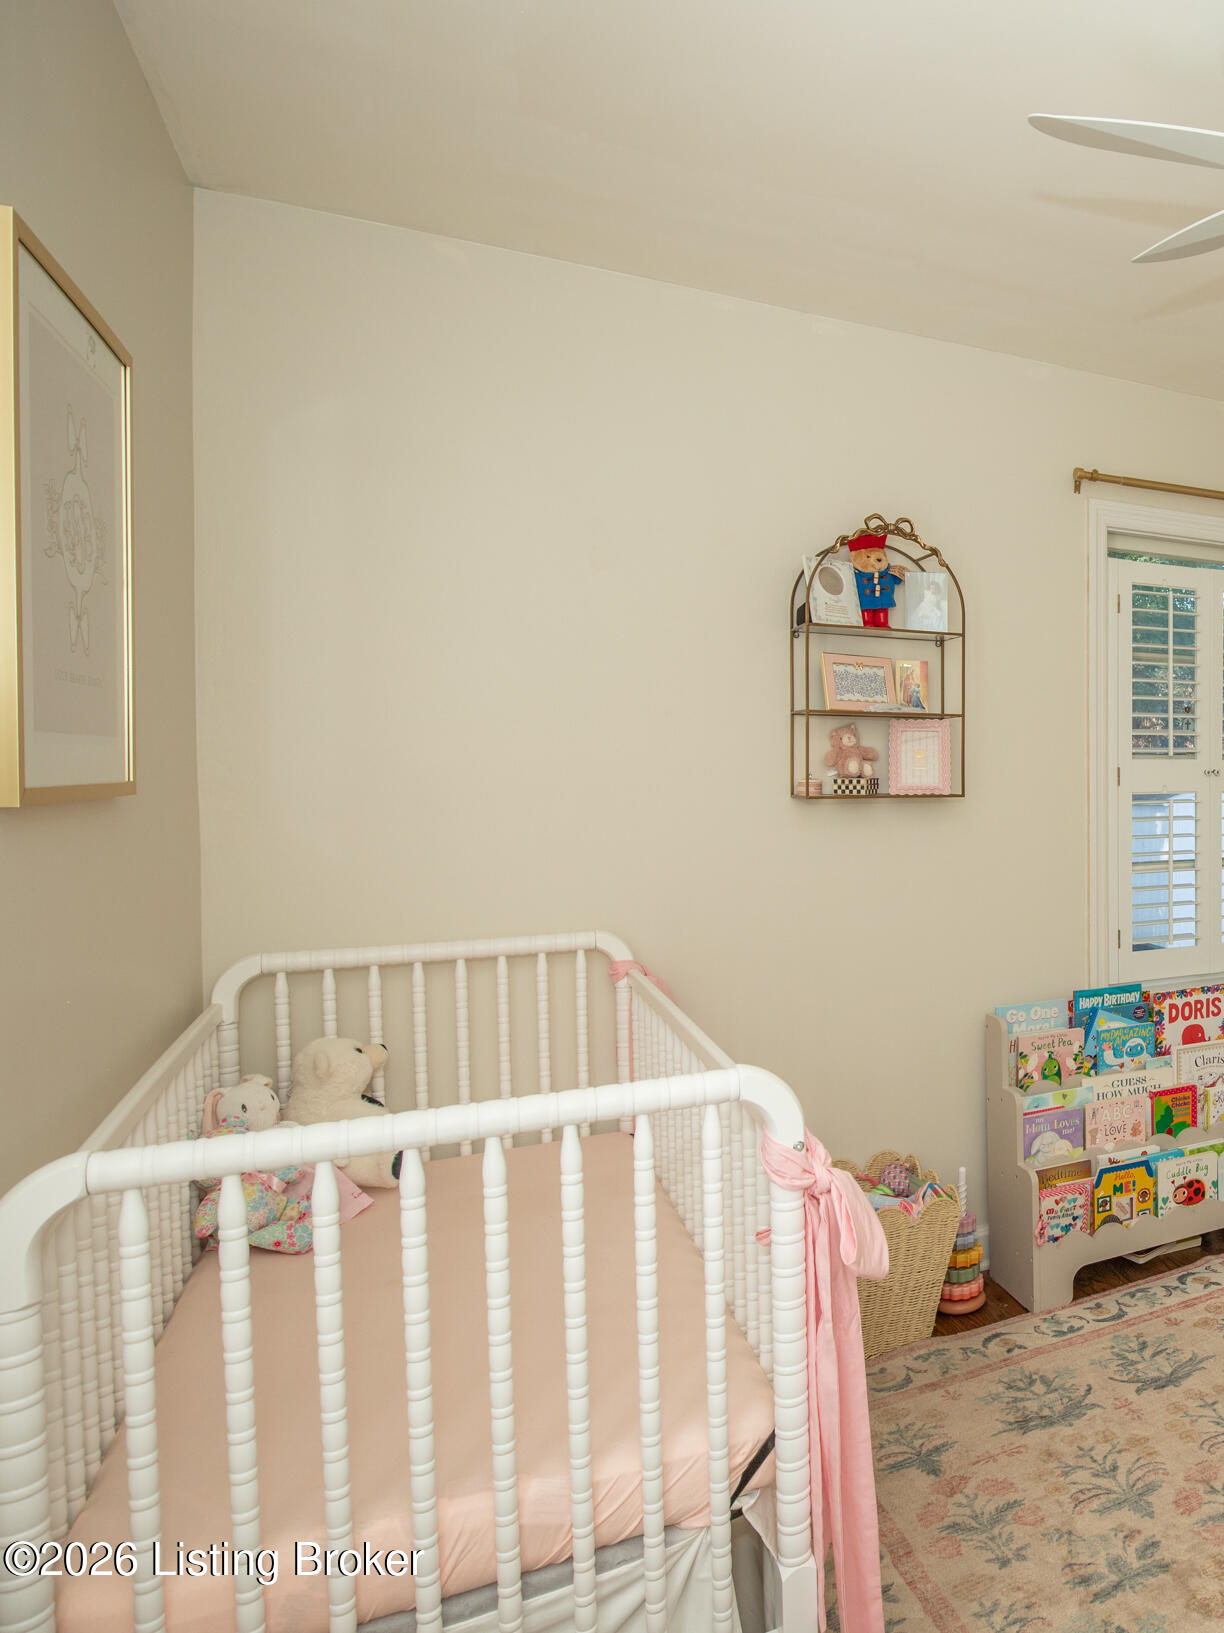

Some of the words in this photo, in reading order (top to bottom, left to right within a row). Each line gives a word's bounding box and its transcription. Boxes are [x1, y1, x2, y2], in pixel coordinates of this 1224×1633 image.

[1079, 996, 1103, 1009] HAPPY
[1104, 991, 1141, 1006] BIRTHDAY
[1030, 1006, 1059, 1020] One
[1168, 997, 1221, 1023] DORIS
[1031, 1039, 1055, 1051] Sweet
[1058, 1037, 1073, 1047] Pea
[1195, 1053, 1224, 1068] Claris
[1112, 1075, 1147, 1088] GUESS
[1097, 1088, 1122, 1101] HOW
[1054, 1117, 1080, 1129] Loves
[1104, 1123, 1127, 1136] LOVE
[1166, 1166, 1192, 1179] Cuddle
[1195, 1163, 1208, 1176] Bug
[1113, 1180, 1136, 1195] ME!
